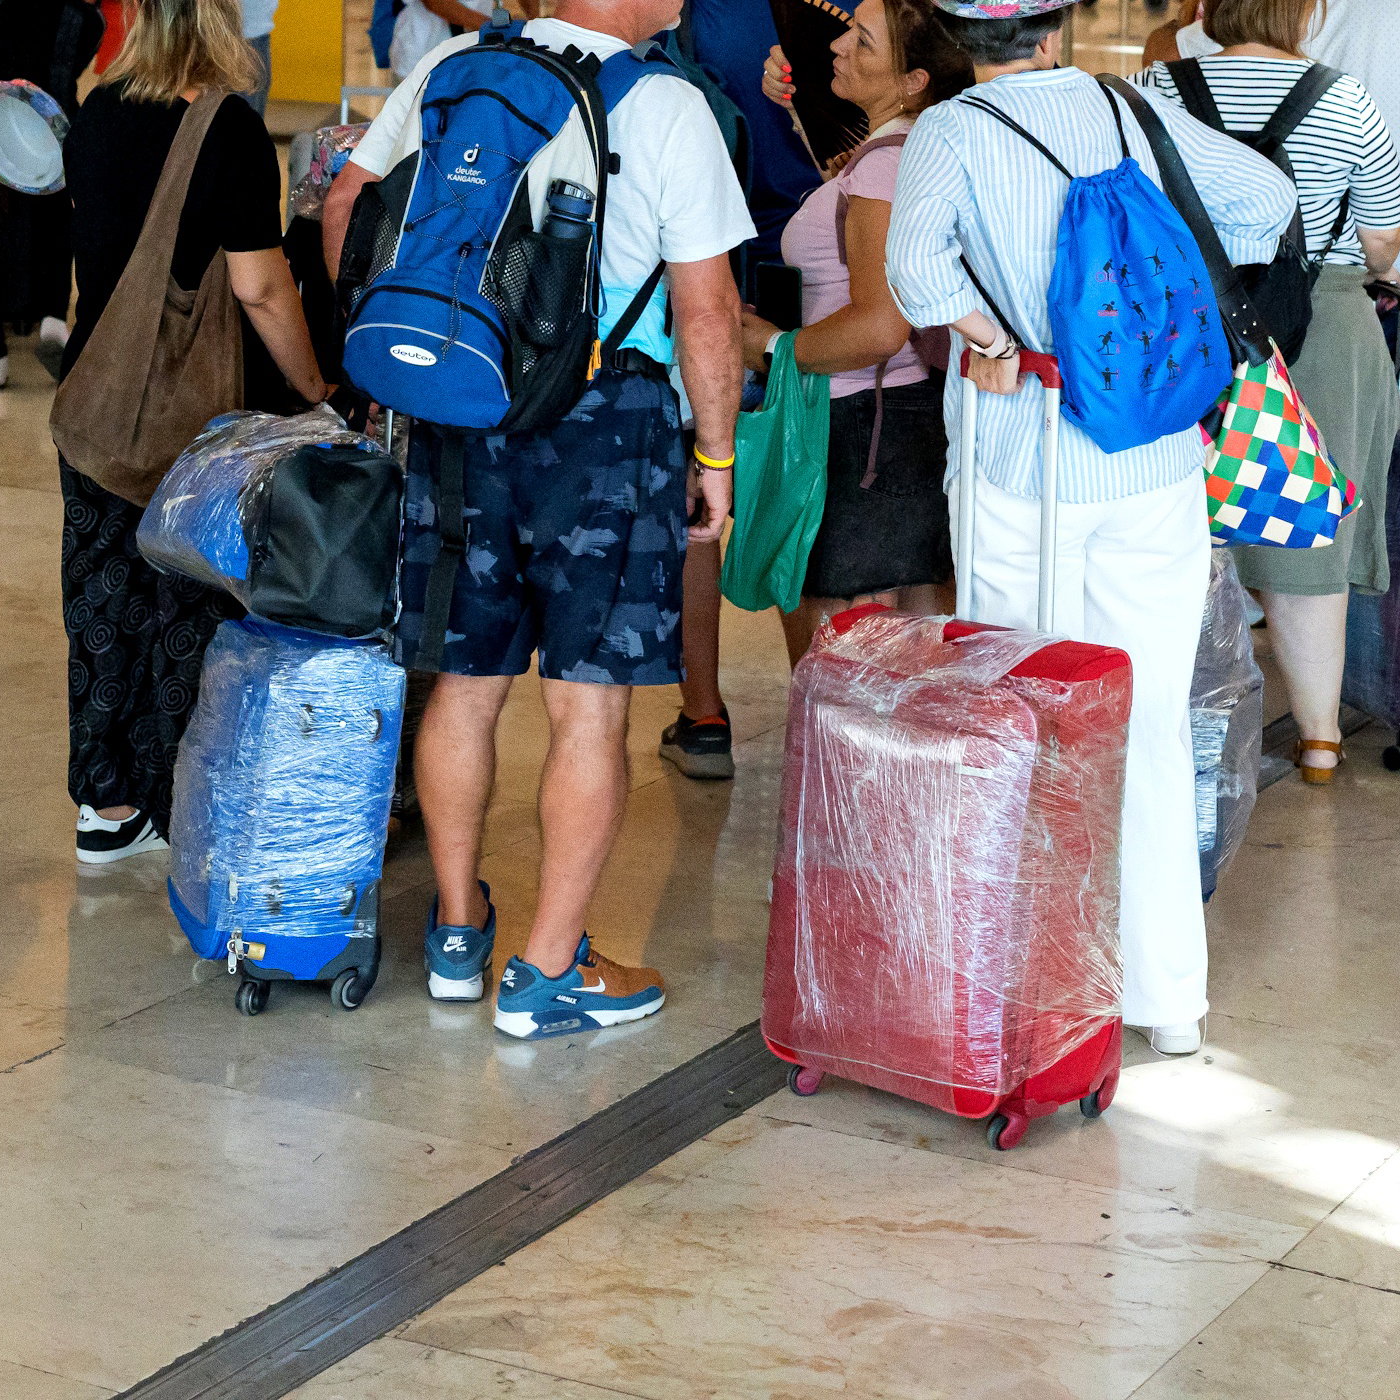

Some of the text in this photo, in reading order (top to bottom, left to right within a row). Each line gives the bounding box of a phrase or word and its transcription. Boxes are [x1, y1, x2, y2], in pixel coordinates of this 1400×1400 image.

[454, 164, 482, 177] deuter
[446, 173, 487, 186] KANGAROO
[392, 348, 435, 362] deuter
[447, 935, 464, 945] NIKE
